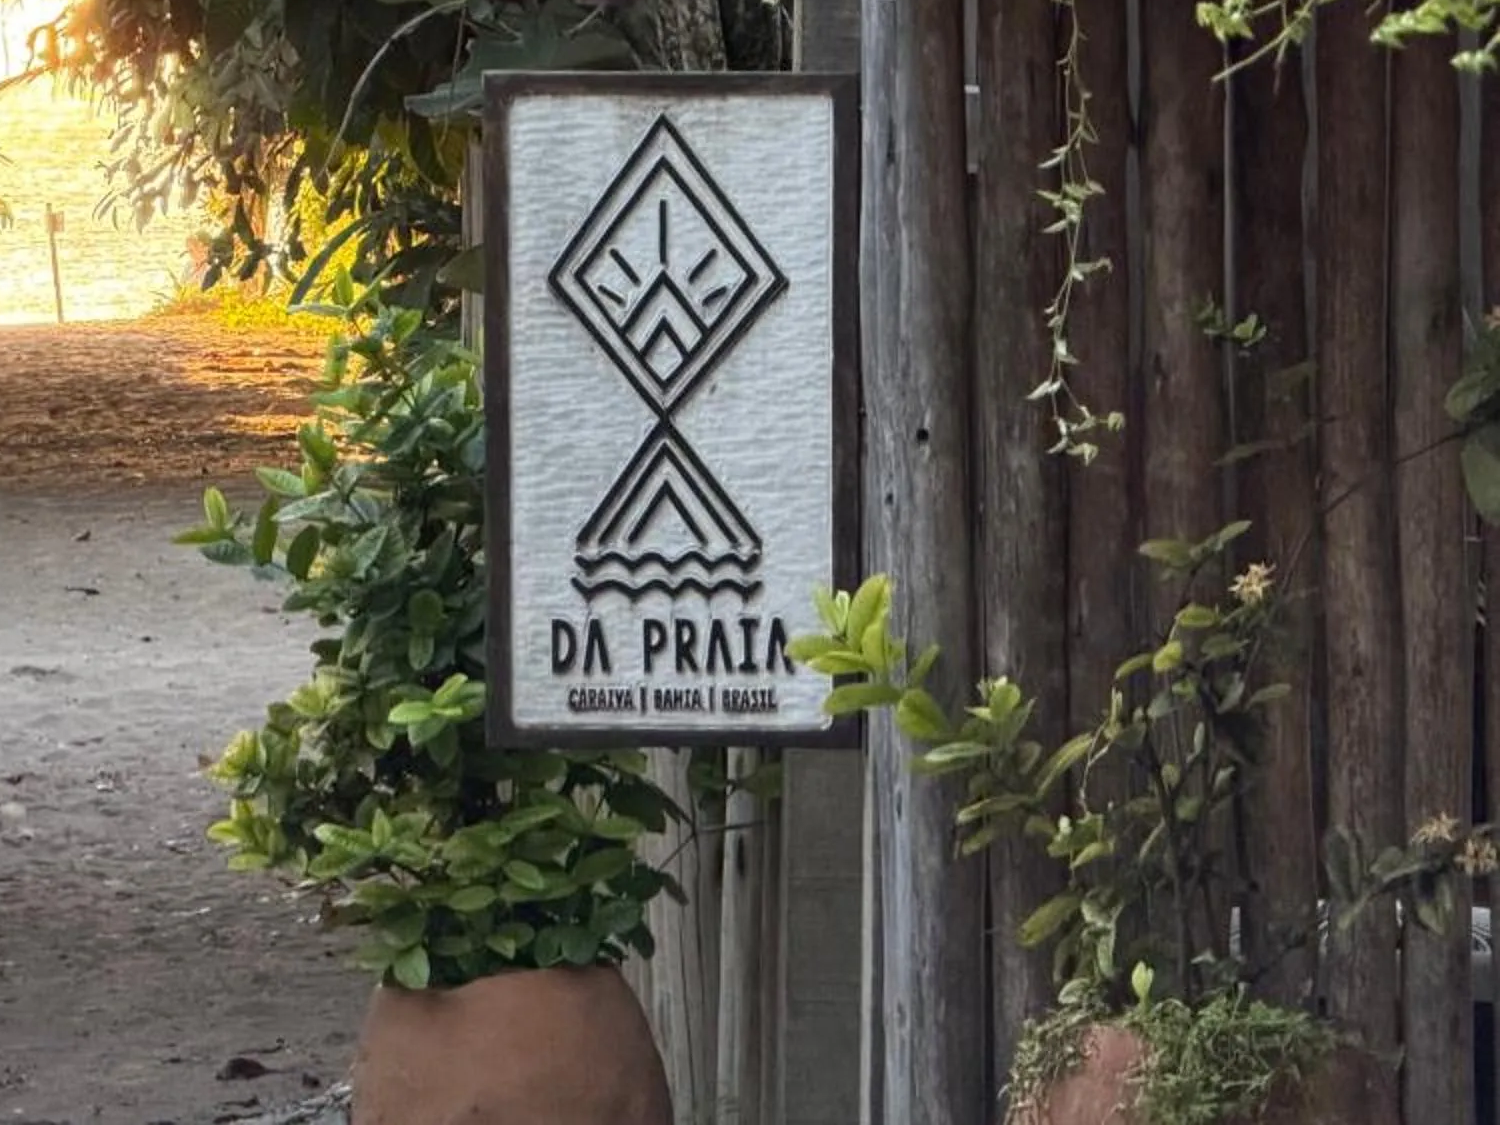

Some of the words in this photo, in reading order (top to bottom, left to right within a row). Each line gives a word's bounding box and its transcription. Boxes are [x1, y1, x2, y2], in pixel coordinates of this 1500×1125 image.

[551, 617, 611, 675] DA
[643, 617, 795, 675] PRAIA
[653, 688, 702, 712] BAHIA
[721, 688, 777, 712] BRASIL
